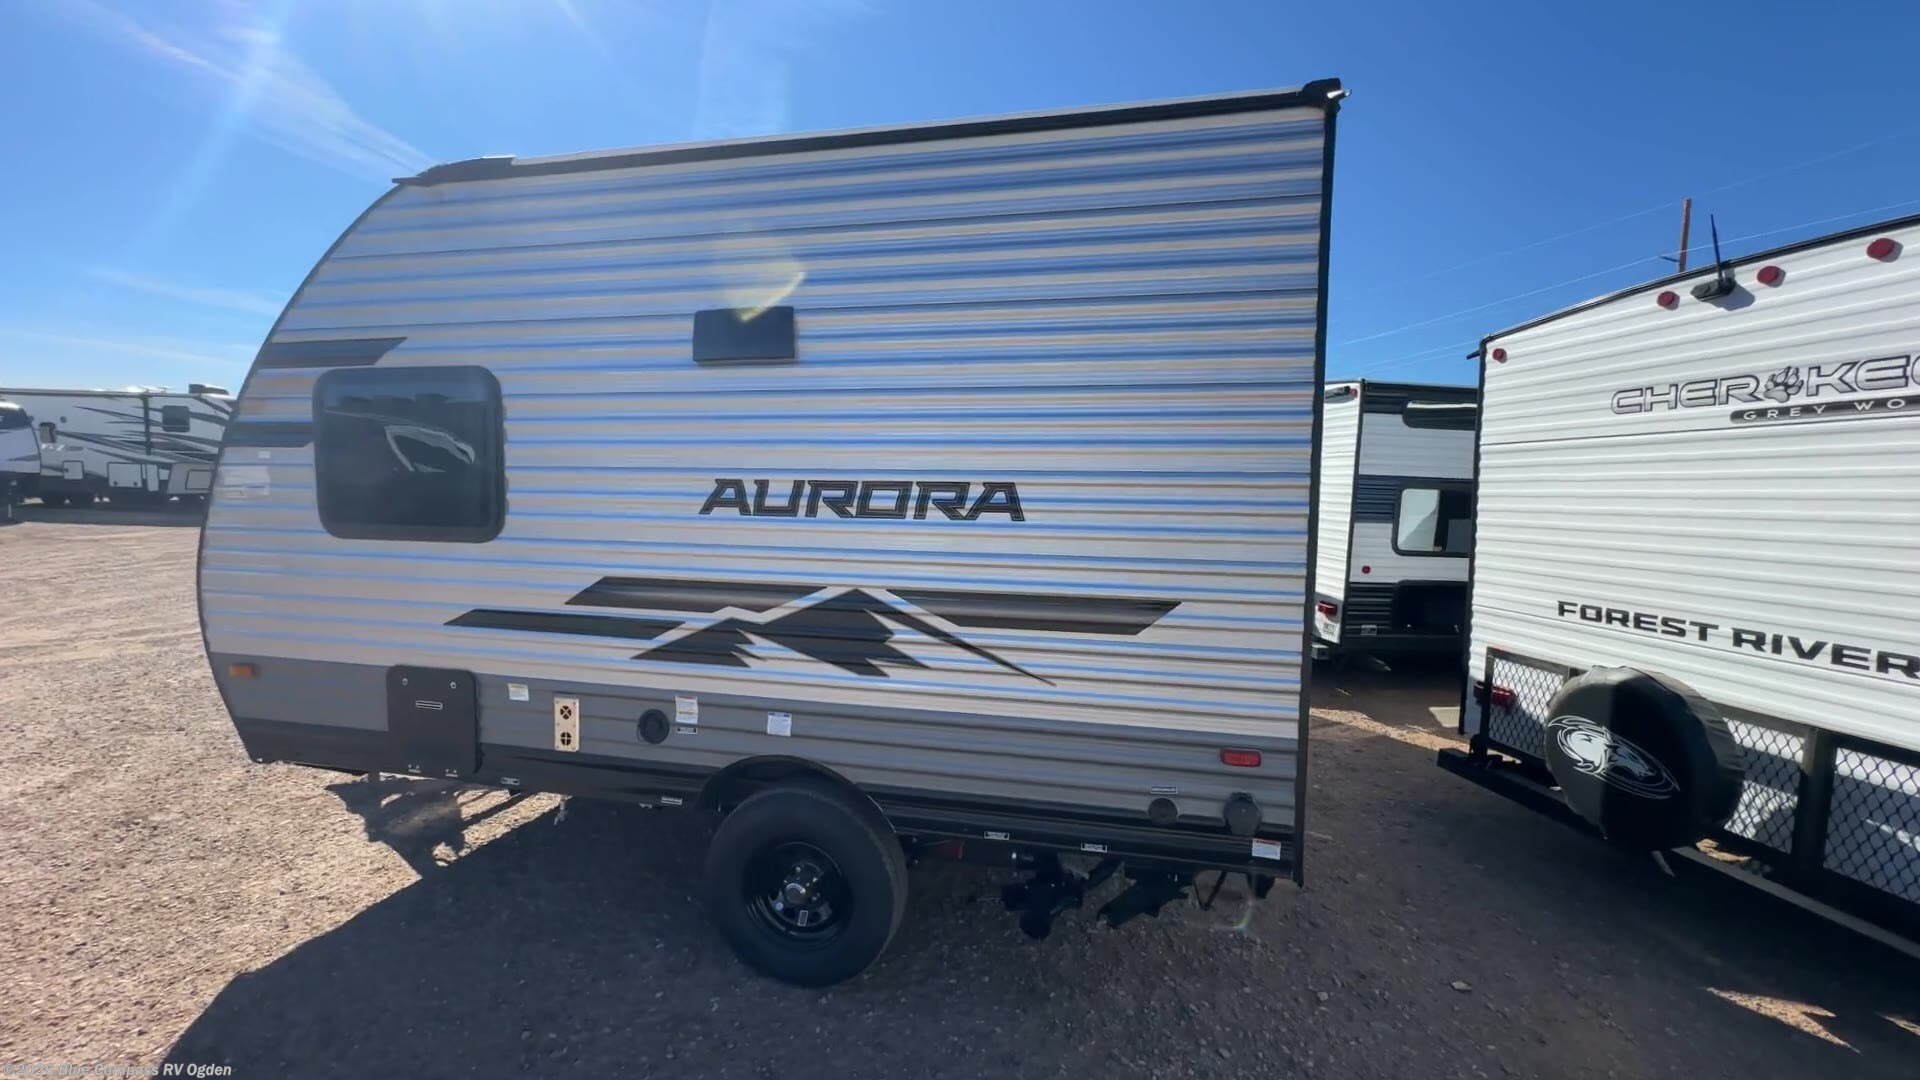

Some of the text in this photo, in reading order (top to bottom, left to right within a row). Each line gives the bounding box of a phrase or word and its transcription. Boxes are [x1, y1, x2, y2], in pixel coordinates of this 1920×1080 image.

[1610, 354, 1920, 415] CHEROKE
[1743, 403, 1827, 422] GREY
[698, 478, 1026, 522] AURORA
[1557, 600, 1920, 680] FOREST RIVER
